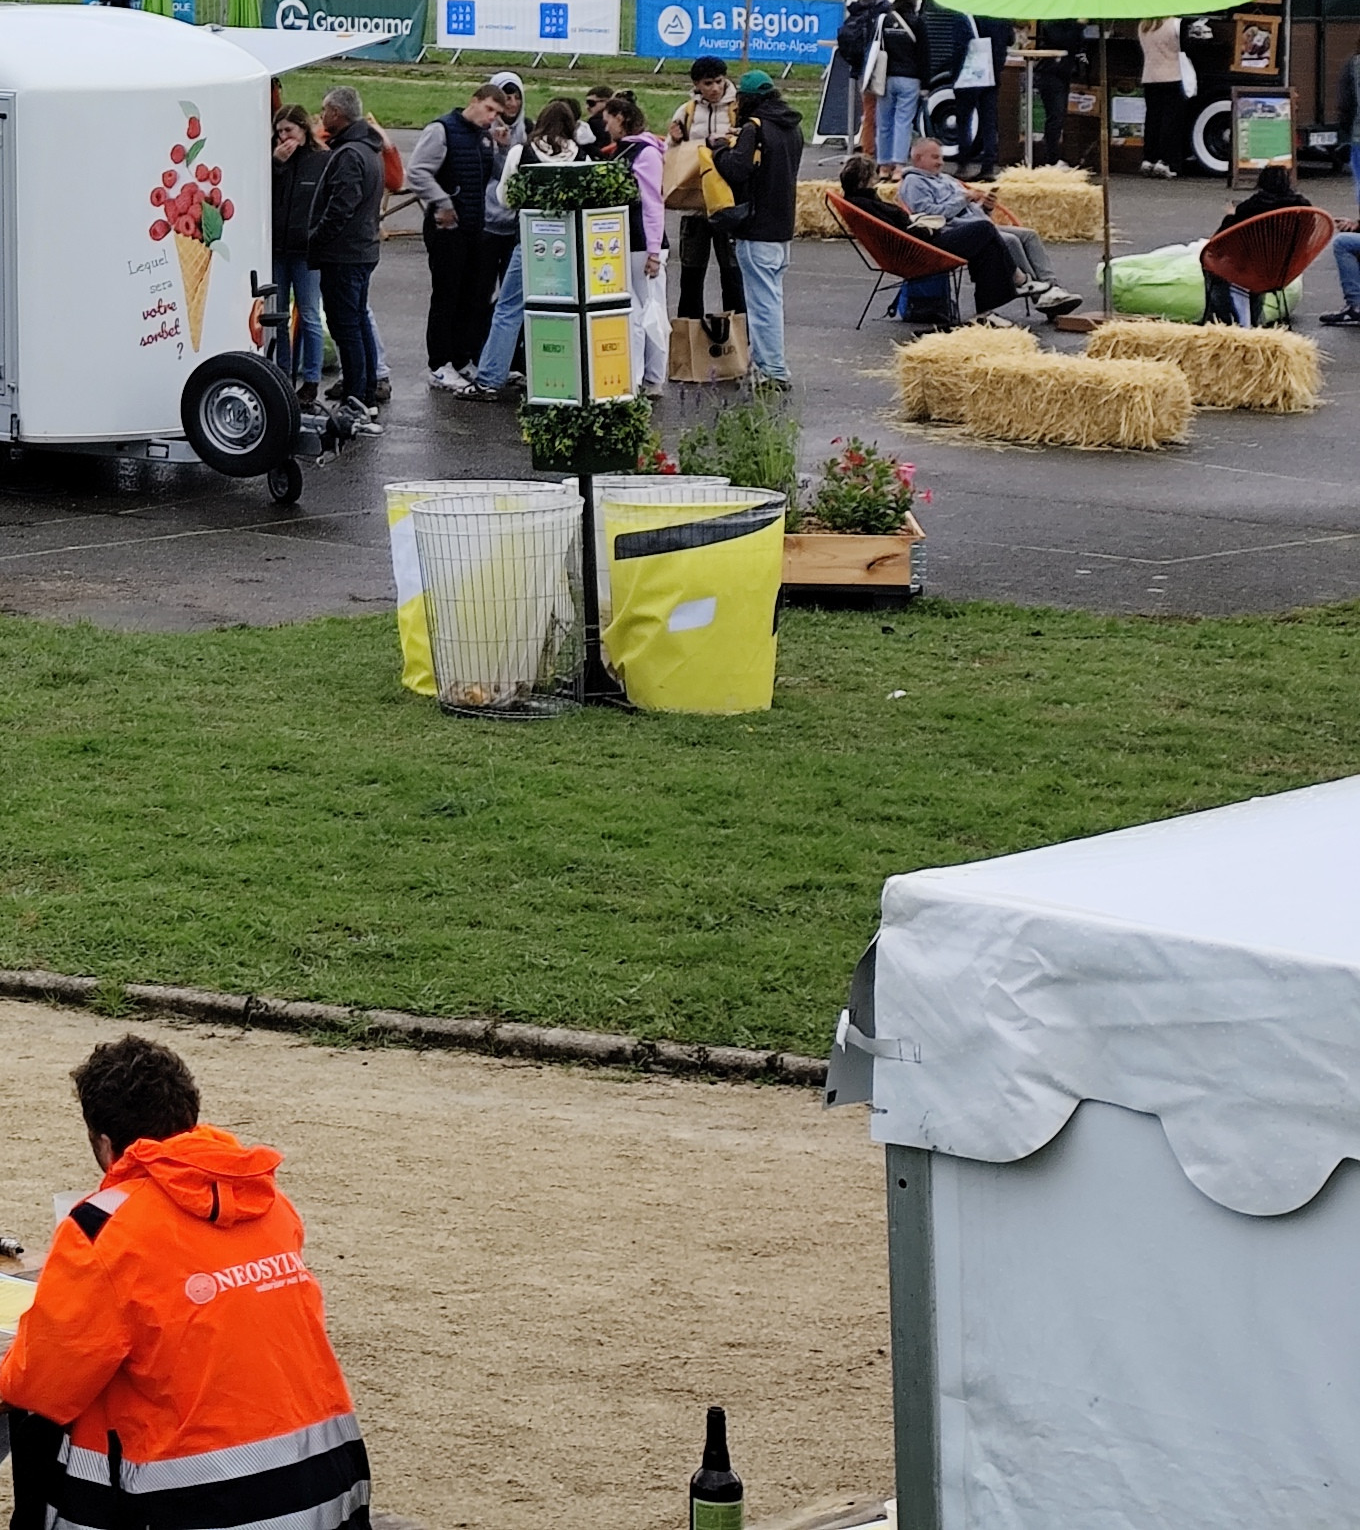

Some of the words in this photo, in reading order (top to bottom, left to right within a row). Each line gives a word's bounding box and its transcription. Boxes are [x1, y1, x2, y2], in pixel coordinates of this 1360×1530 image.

[312, 10, 414, 35] Groupama
[697, 5, 726, 30] La
[732, 5, 820, 38] Région
[127, 248, 169, 275] Lequel
[149, 280, 173, 294] sera
[141, 297, 178, 320] votre
[139, 317, 181, 347] sorbet
[176, 341, 184, 360] ?
